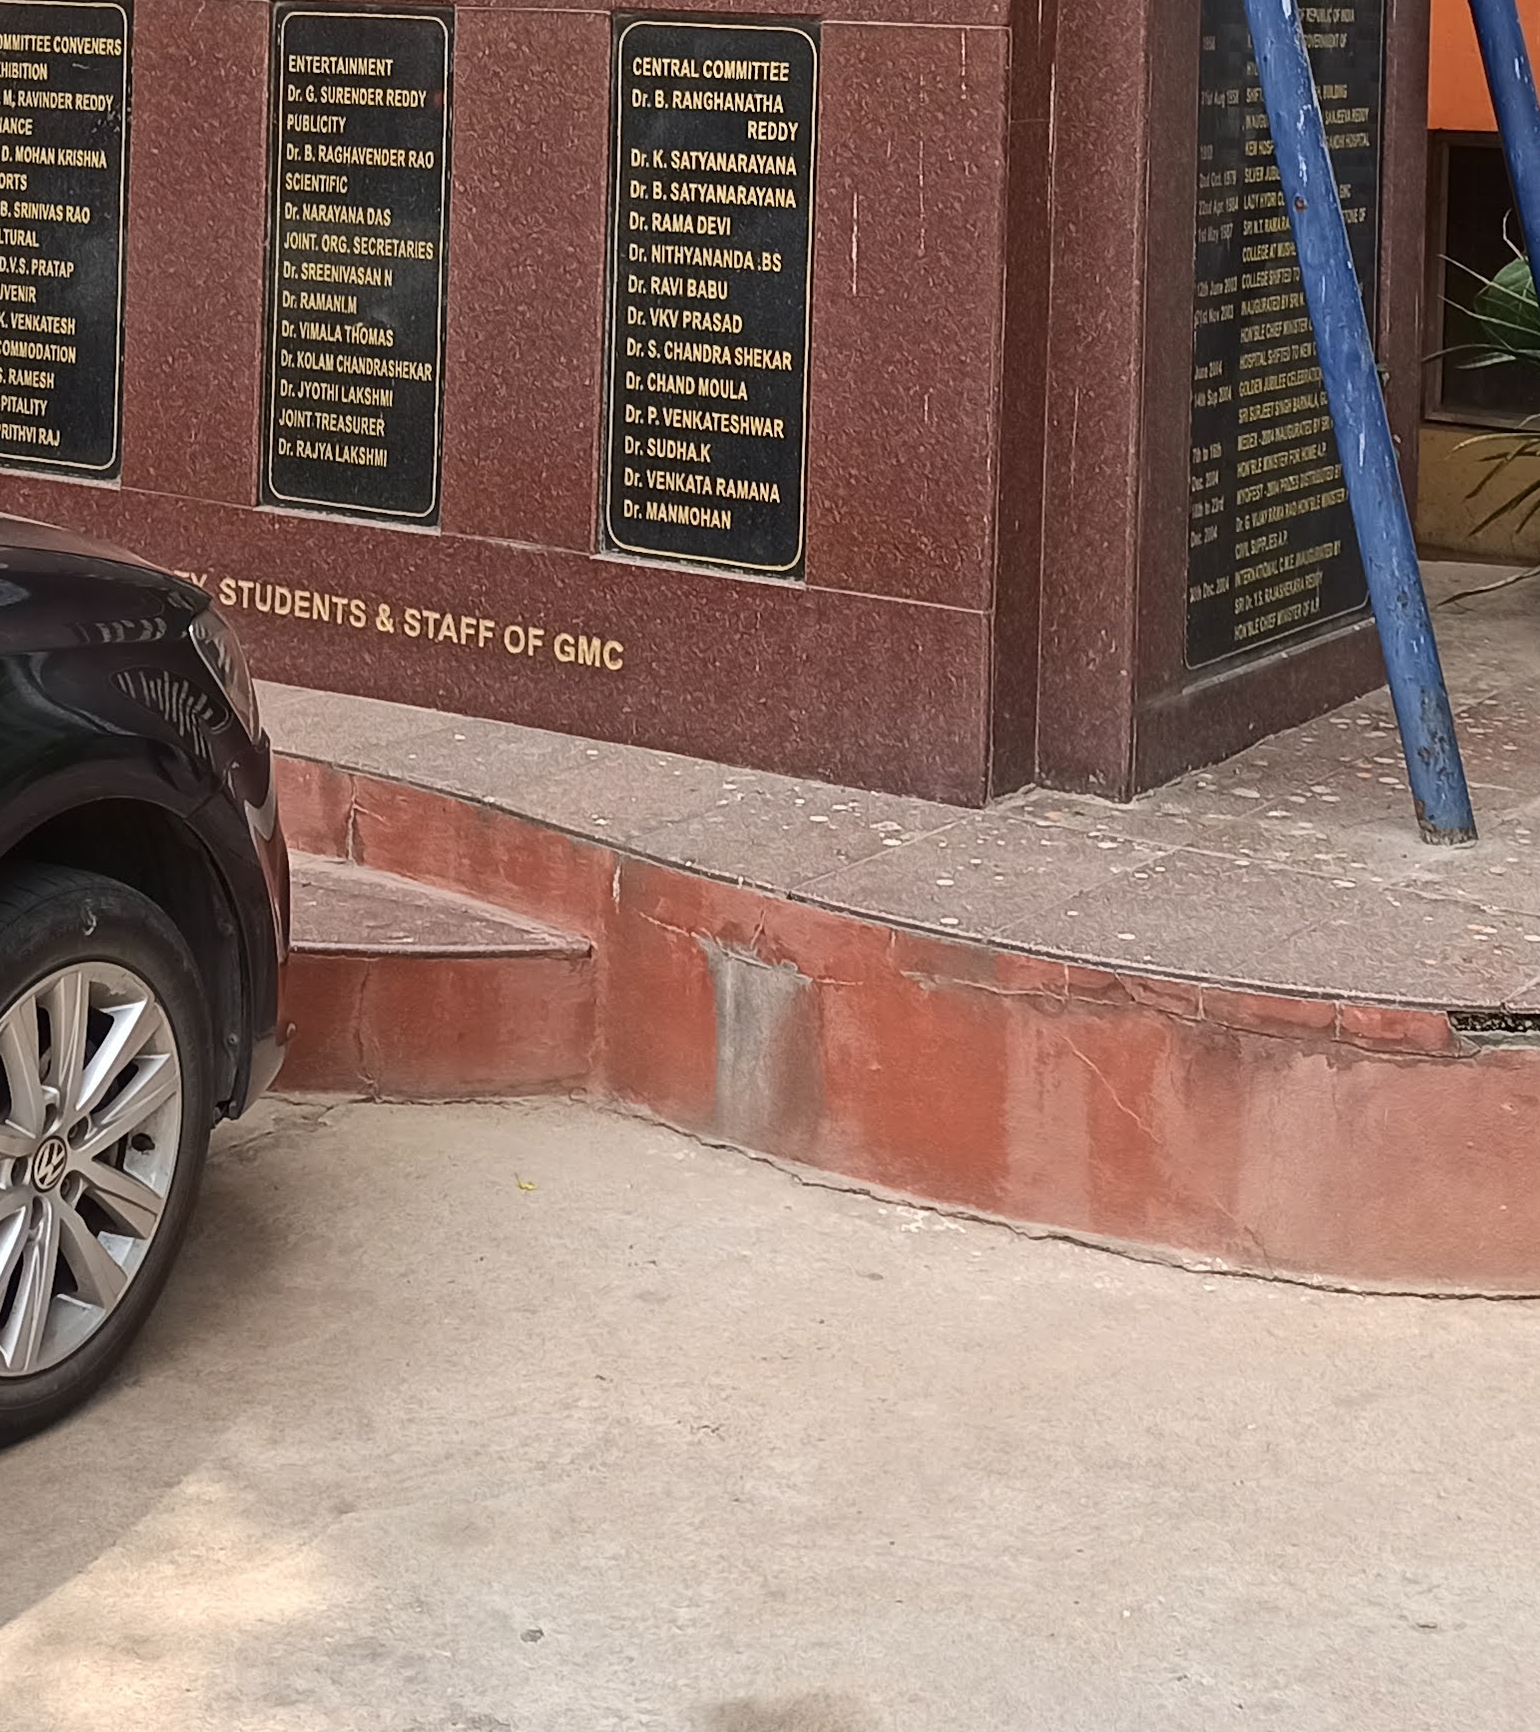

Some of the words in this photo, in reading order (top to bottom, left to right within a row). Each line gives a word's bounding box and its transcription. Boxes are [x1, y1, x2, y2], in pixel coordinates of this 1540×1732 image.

[53, 36, 122, 56] CONVENERS
[288, 54, 393, 76] ENTERTAINMENT
[632, 57, 699, 78] CENTRAL
[702, 60, 789, 81] COMMITTEE
[288, 84, 302, 103] Dr.
[306, 86, 318, 103] G.
[321, 86, 384, 106] SURENDER
[386, 89, 426, 107] REDDY
[632, 89, 651, 108] Dr.
[655, 90, 668, 109] B.
[672, 90, 784, 113] RANGHANATHA
[287, 114, 346, 134] PUBLICITY
[747, 120, 798, 141] REDDY
[1, 145, 12, 162] D.
[15, 146, 55, 165] MOHAN
[58, 148, 107, 168] KRISHNA
[286, 143, 301, 161] Dr.
[304, 144, 316, 163] B.
[318, 145, 407, 167] RAGHAVENDER
[409, 150, 434, 169] RAO
[631, 148, 650, 168] Dr.
[653, 150, 667, 169] K.
[670, 150, 797, 176] SATYANARAYANA
[285, 172, 348, 194] SCIENTIFIC
[0, 201, 11, 218] B.
[14, 202, 63, 222] SRINIVAS
[66, 206, 90, 224] RAO
[284, 202, 300, 219] Dr.
[303, 203, 364, 224] NARAYANA
[366, 207, 391, 227] DAS
[629, 211, 648, 230] Dr.
[652, 212, 694, 233] RAMA
[697, 216, 731, 235] DEVI
[283, 261, 299, 280] Dr.
[300, 262, 381, 286] SREENIVASAN
[384, 268, 393, 286] N
[628, 275, 646, 294] Dr.
[650, 277, 683, 296] RAVI
[687, 280, 728, 300] BABU
[11, 312, 76, 335] VENKATESH
[627, 306, 646, 325] Dr.
[649, 308, 679, 329] VKV
[682, 311, 743, 333] PRASAD
[281, 320, 297, 338] Dr.
[299, 321, 342, 342] VIMALA
[345, 325, 394, 347] THOMAS
[281, 349, 295, 368] Dr.
[297, 350, 334, 371] KOLAM
[337, 354, 432, 381] CHANDRASHEKAR
[8, 368, 55, 389] RAMESH
[626, 371, 643, 391] Dr.
[647, 372, 695, 394] CHAND
[698, 377, 748, 401] MOULA
[280, 378, 295, 397] Dr.
[298, 381, 339, 402] JYOTHI
[341, 385, 393, 407] LAKSHMI
[38, 427, 60, 447] RAJ
[278, 438, 294, 456] Dr.
[296, 440, 333, 461] RAJYA
[335, 444, 387, 467] LAKSHMI
[624, 467, 643, 487] Dr.
[646, 469, 712, 495] VENKATA
[716, 478, 780, 503] RAMANA
[623, 499, 642, 519] Dr.
[646, 501, 731, 530] MANMOHAN
[219, 578, 367, 629] STUDENTS
[375, 603, 395, 634] &
[403, 608, 496, 648] STAFF
[504, 625, 545, 657] OF
[554, 633, 624, 671] GMC
